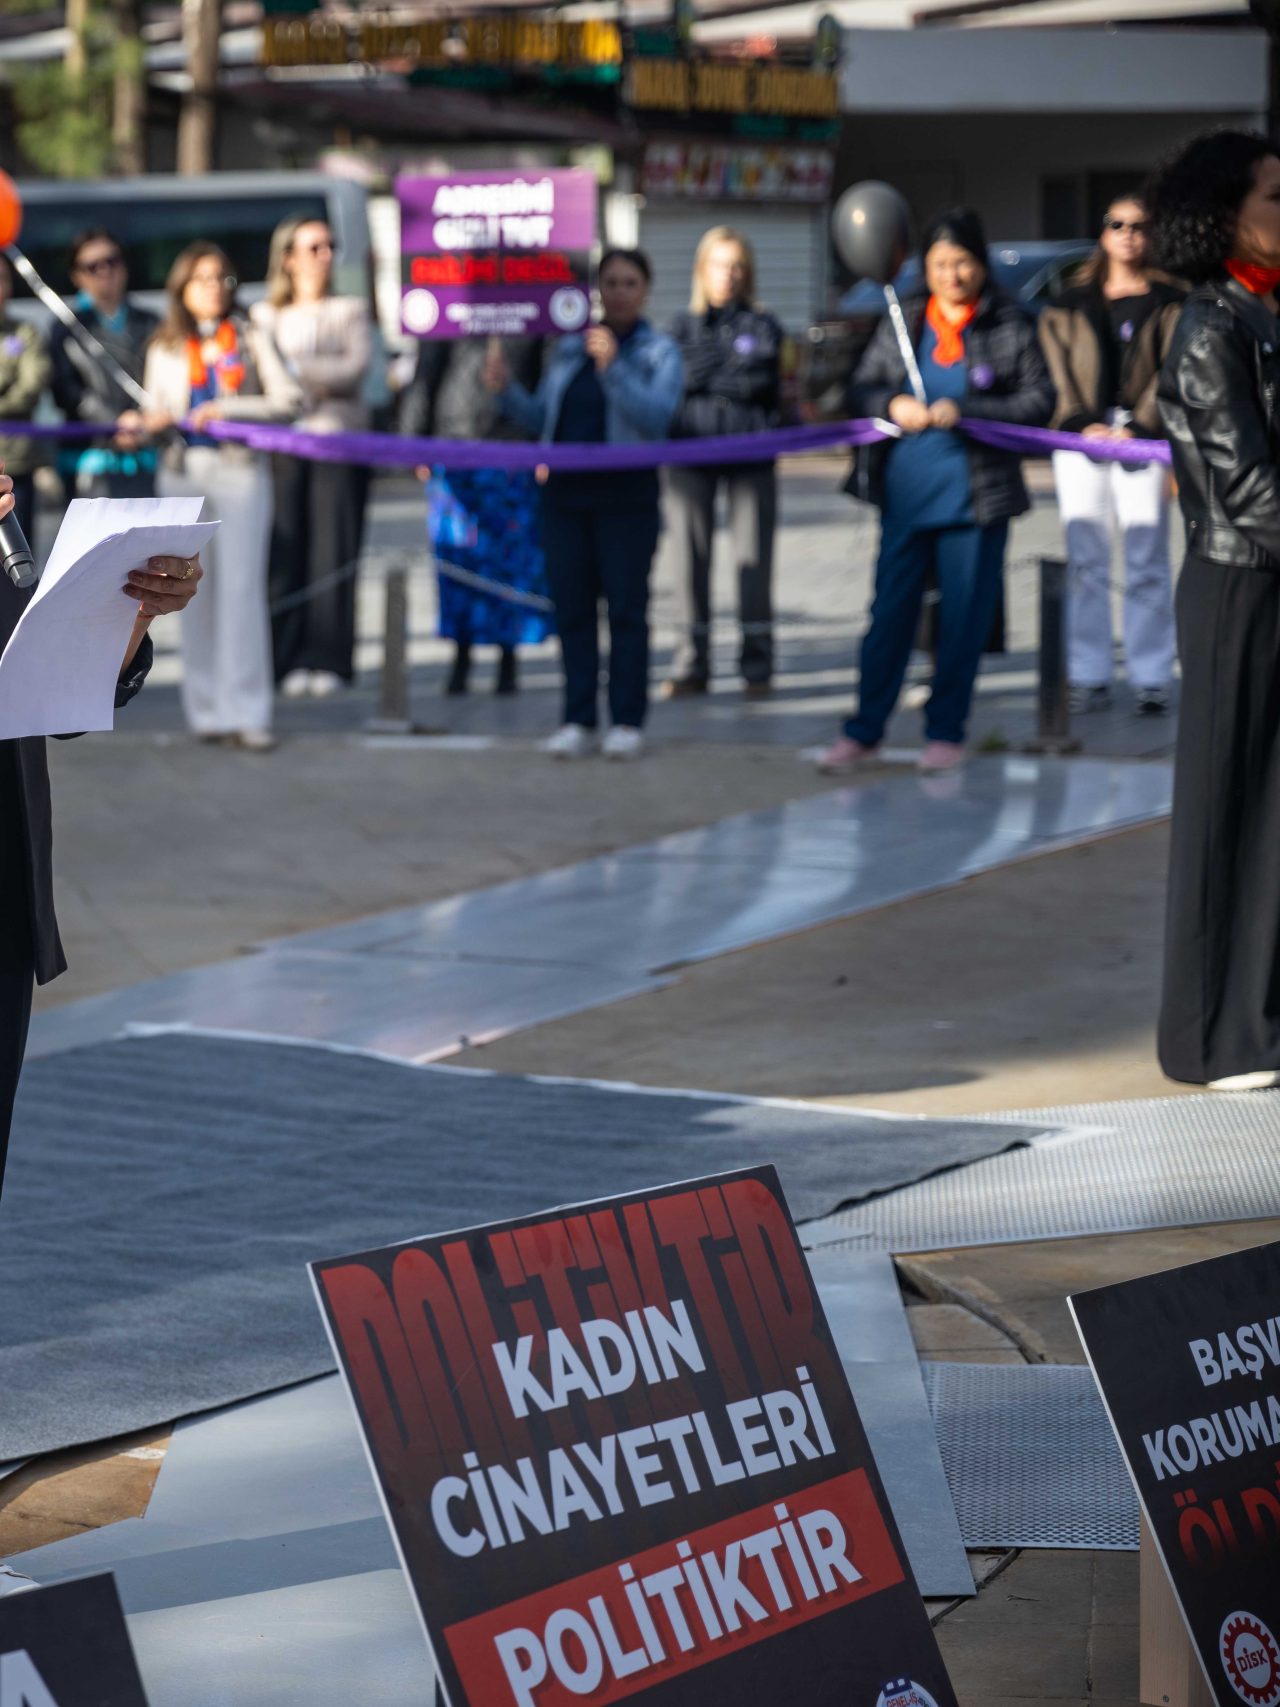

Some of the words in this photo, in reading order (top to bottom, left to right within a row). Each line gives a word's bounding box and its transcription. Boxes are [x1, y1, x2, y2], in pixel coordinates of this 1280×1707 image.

[491, 1299, 707, 1419] KADIN
[1188, 1316, 1280, 1387] BAŞV
[430, 1365, 837, 1558] CİNAYETLERİ
[1173, 1460, 1280, 1570] ÖLD
[494, 1503, 863, 1707] POLİTİKTİR
[1237, 1647, 1268, 1672] DİSK
